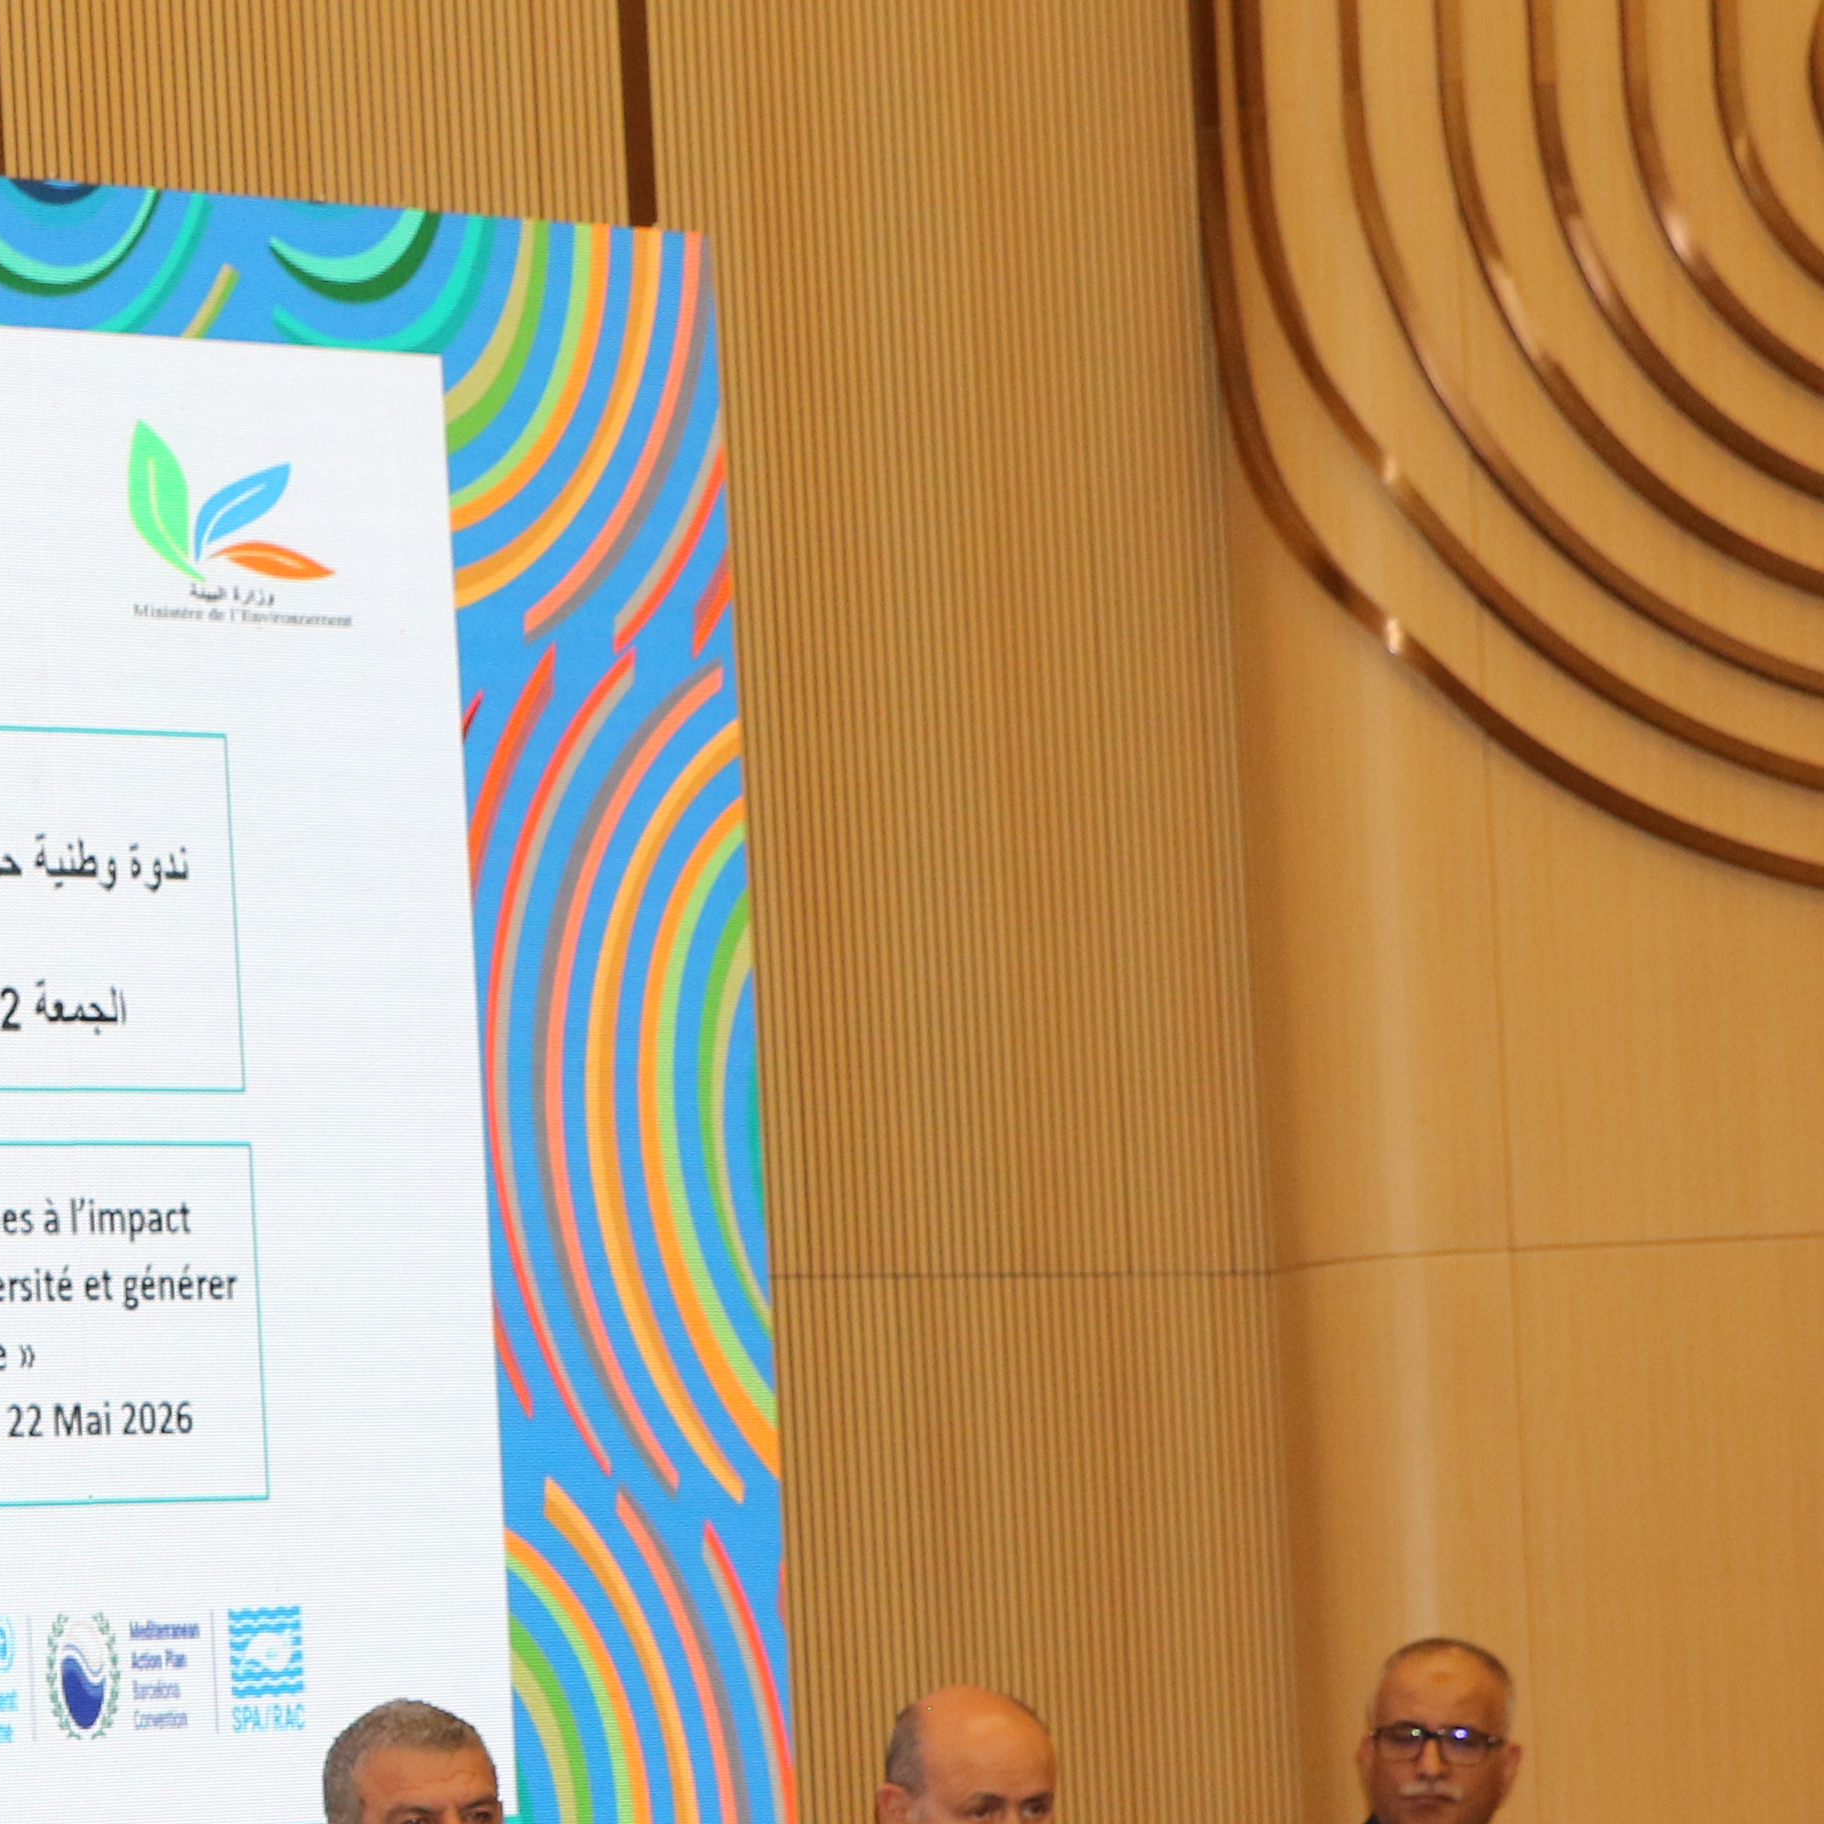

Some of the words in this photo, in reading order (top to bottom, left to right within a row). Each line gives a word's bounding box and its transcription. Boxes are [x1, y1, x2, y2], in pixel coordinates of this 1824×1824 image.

[34, 833, 118, 891] وطنية
[129, 843, 189, 893] ندوة
[35, 979, 126, 1034] الجمعة
[43, 1198, 61, 1235] à
[84, 1269, 113, 1302] et
[123, 1264, 238, 1311] générer
[8, 1403, 43, 1438] 22
[53, 1401, 112, 1437] Mai
[121, 1400, 194, 1436] 2026
